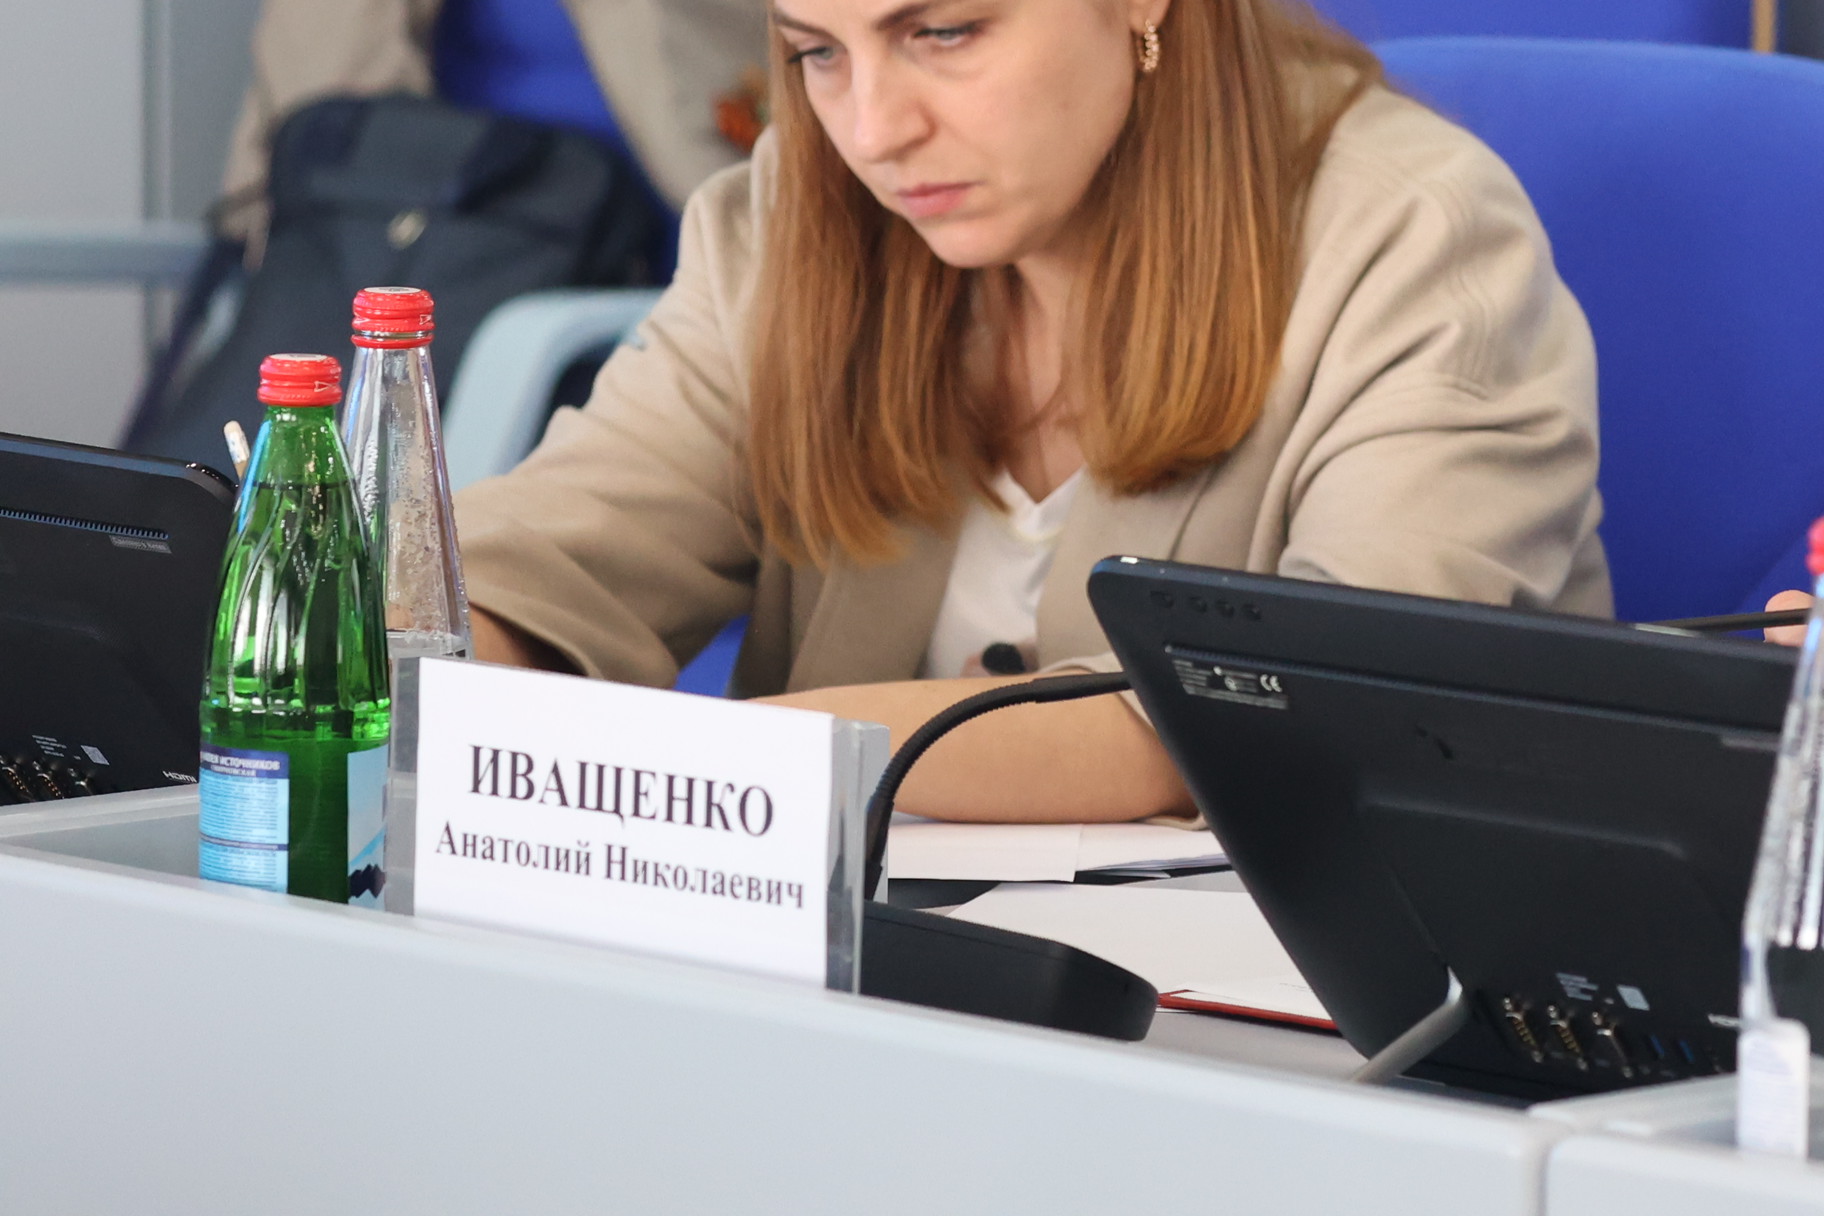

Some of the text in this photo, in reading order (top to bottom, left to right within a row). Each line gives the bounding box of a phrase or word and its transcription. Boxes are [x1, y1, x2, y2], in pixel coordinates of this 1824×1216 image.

[468, 744, 774, 838] ИВАЩЕНКО
[436, 820, 805, 910] Анатолий Николаевич
